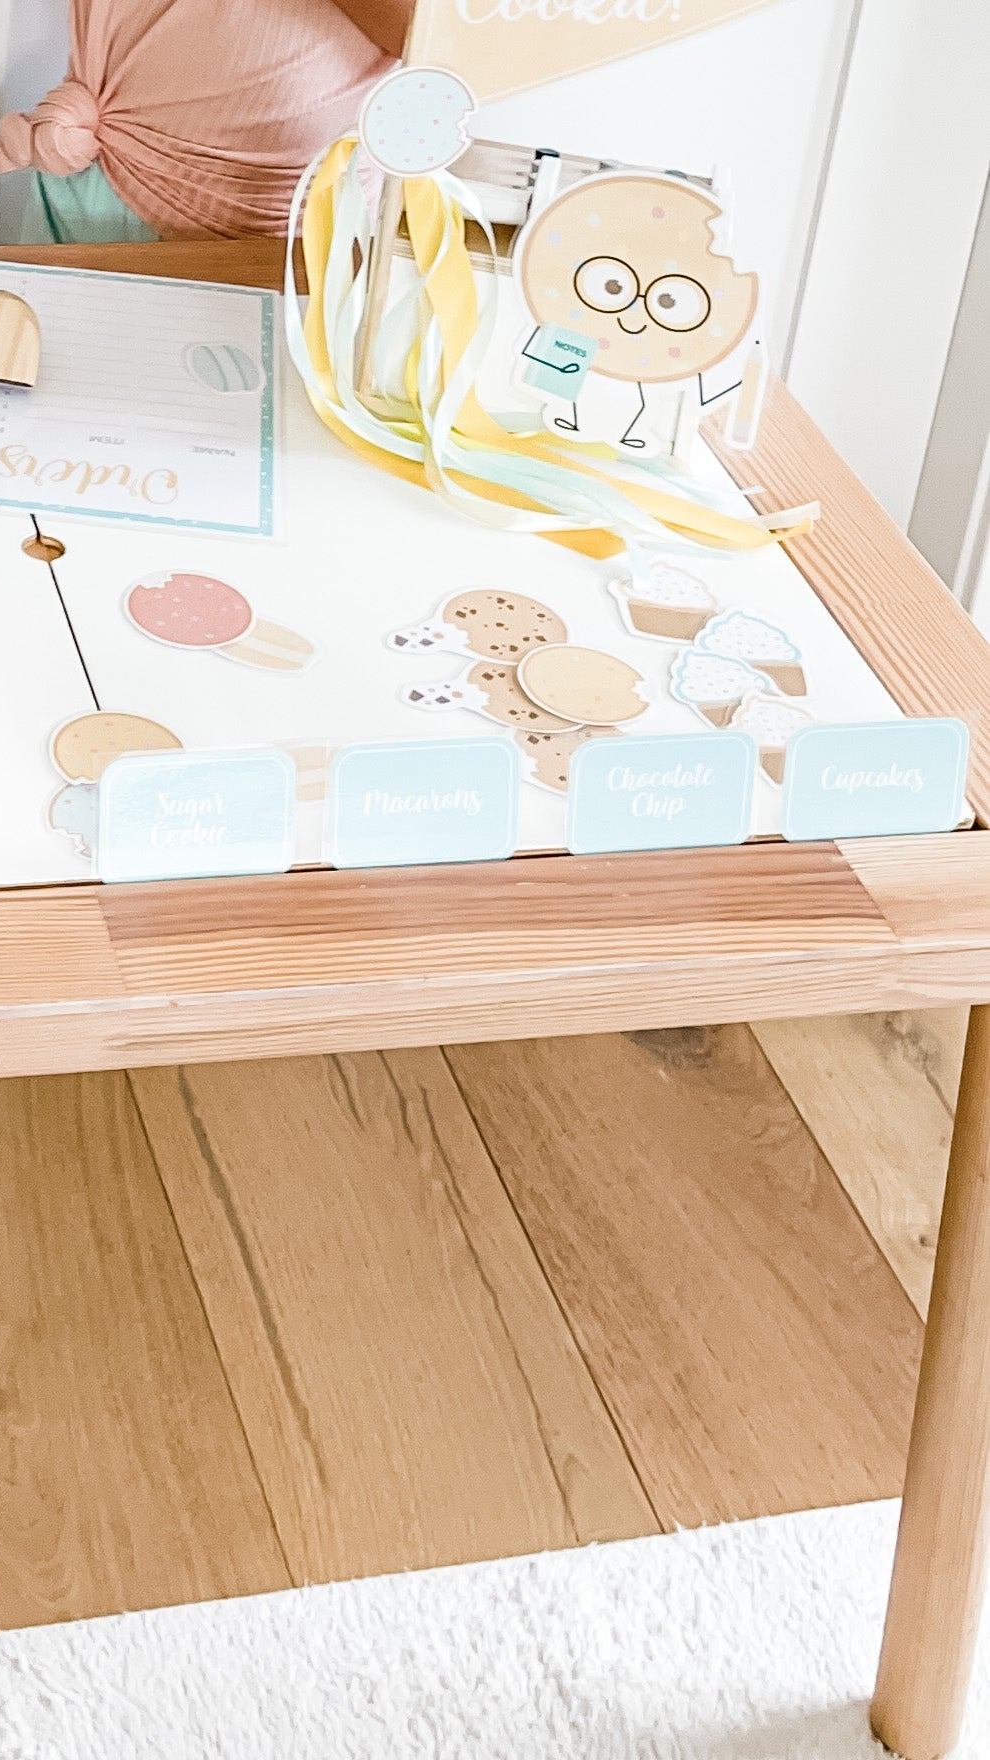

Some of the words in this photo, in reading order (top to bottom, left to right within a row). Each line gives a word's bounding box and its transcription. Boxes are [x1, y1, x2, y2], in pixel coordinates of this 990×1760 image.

[554, 340, 588, 358] NOTES
[89, 435, 125, 445] ITEM
[191, 445, 236, 456] NAME
[608, 762, 714, 791] Chocolate
[821, 762, 925, 795] Cupcakes
[155, 792, 226, 825] Sugar
[364, 787, 481, 816] Macarons
[632, 792, 686, 821] Chip
[151, 820, 230, 849] Cookie
